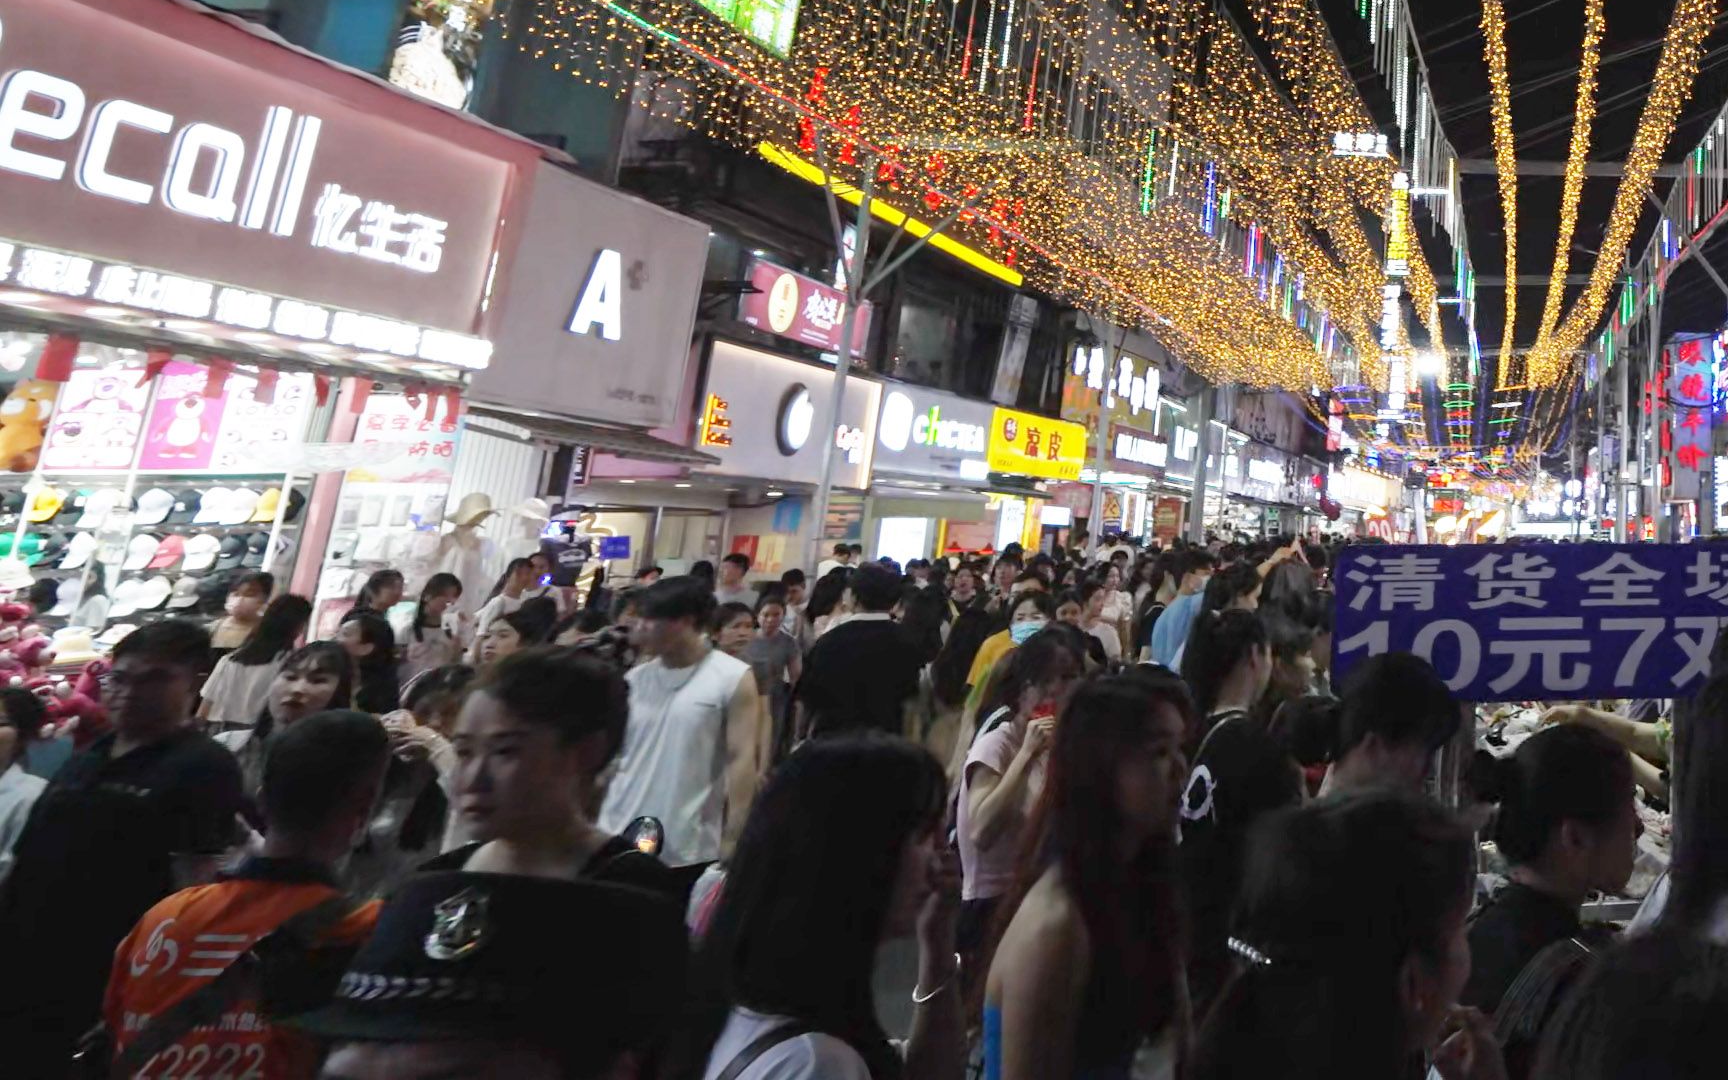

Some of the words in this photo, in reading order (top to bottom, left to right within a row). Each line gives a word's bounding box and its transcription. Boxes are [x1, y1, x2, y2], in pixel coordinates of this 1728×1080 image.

[0, 68, 323, 237] ecall
[310, 182, 448, 274] 忆生活
